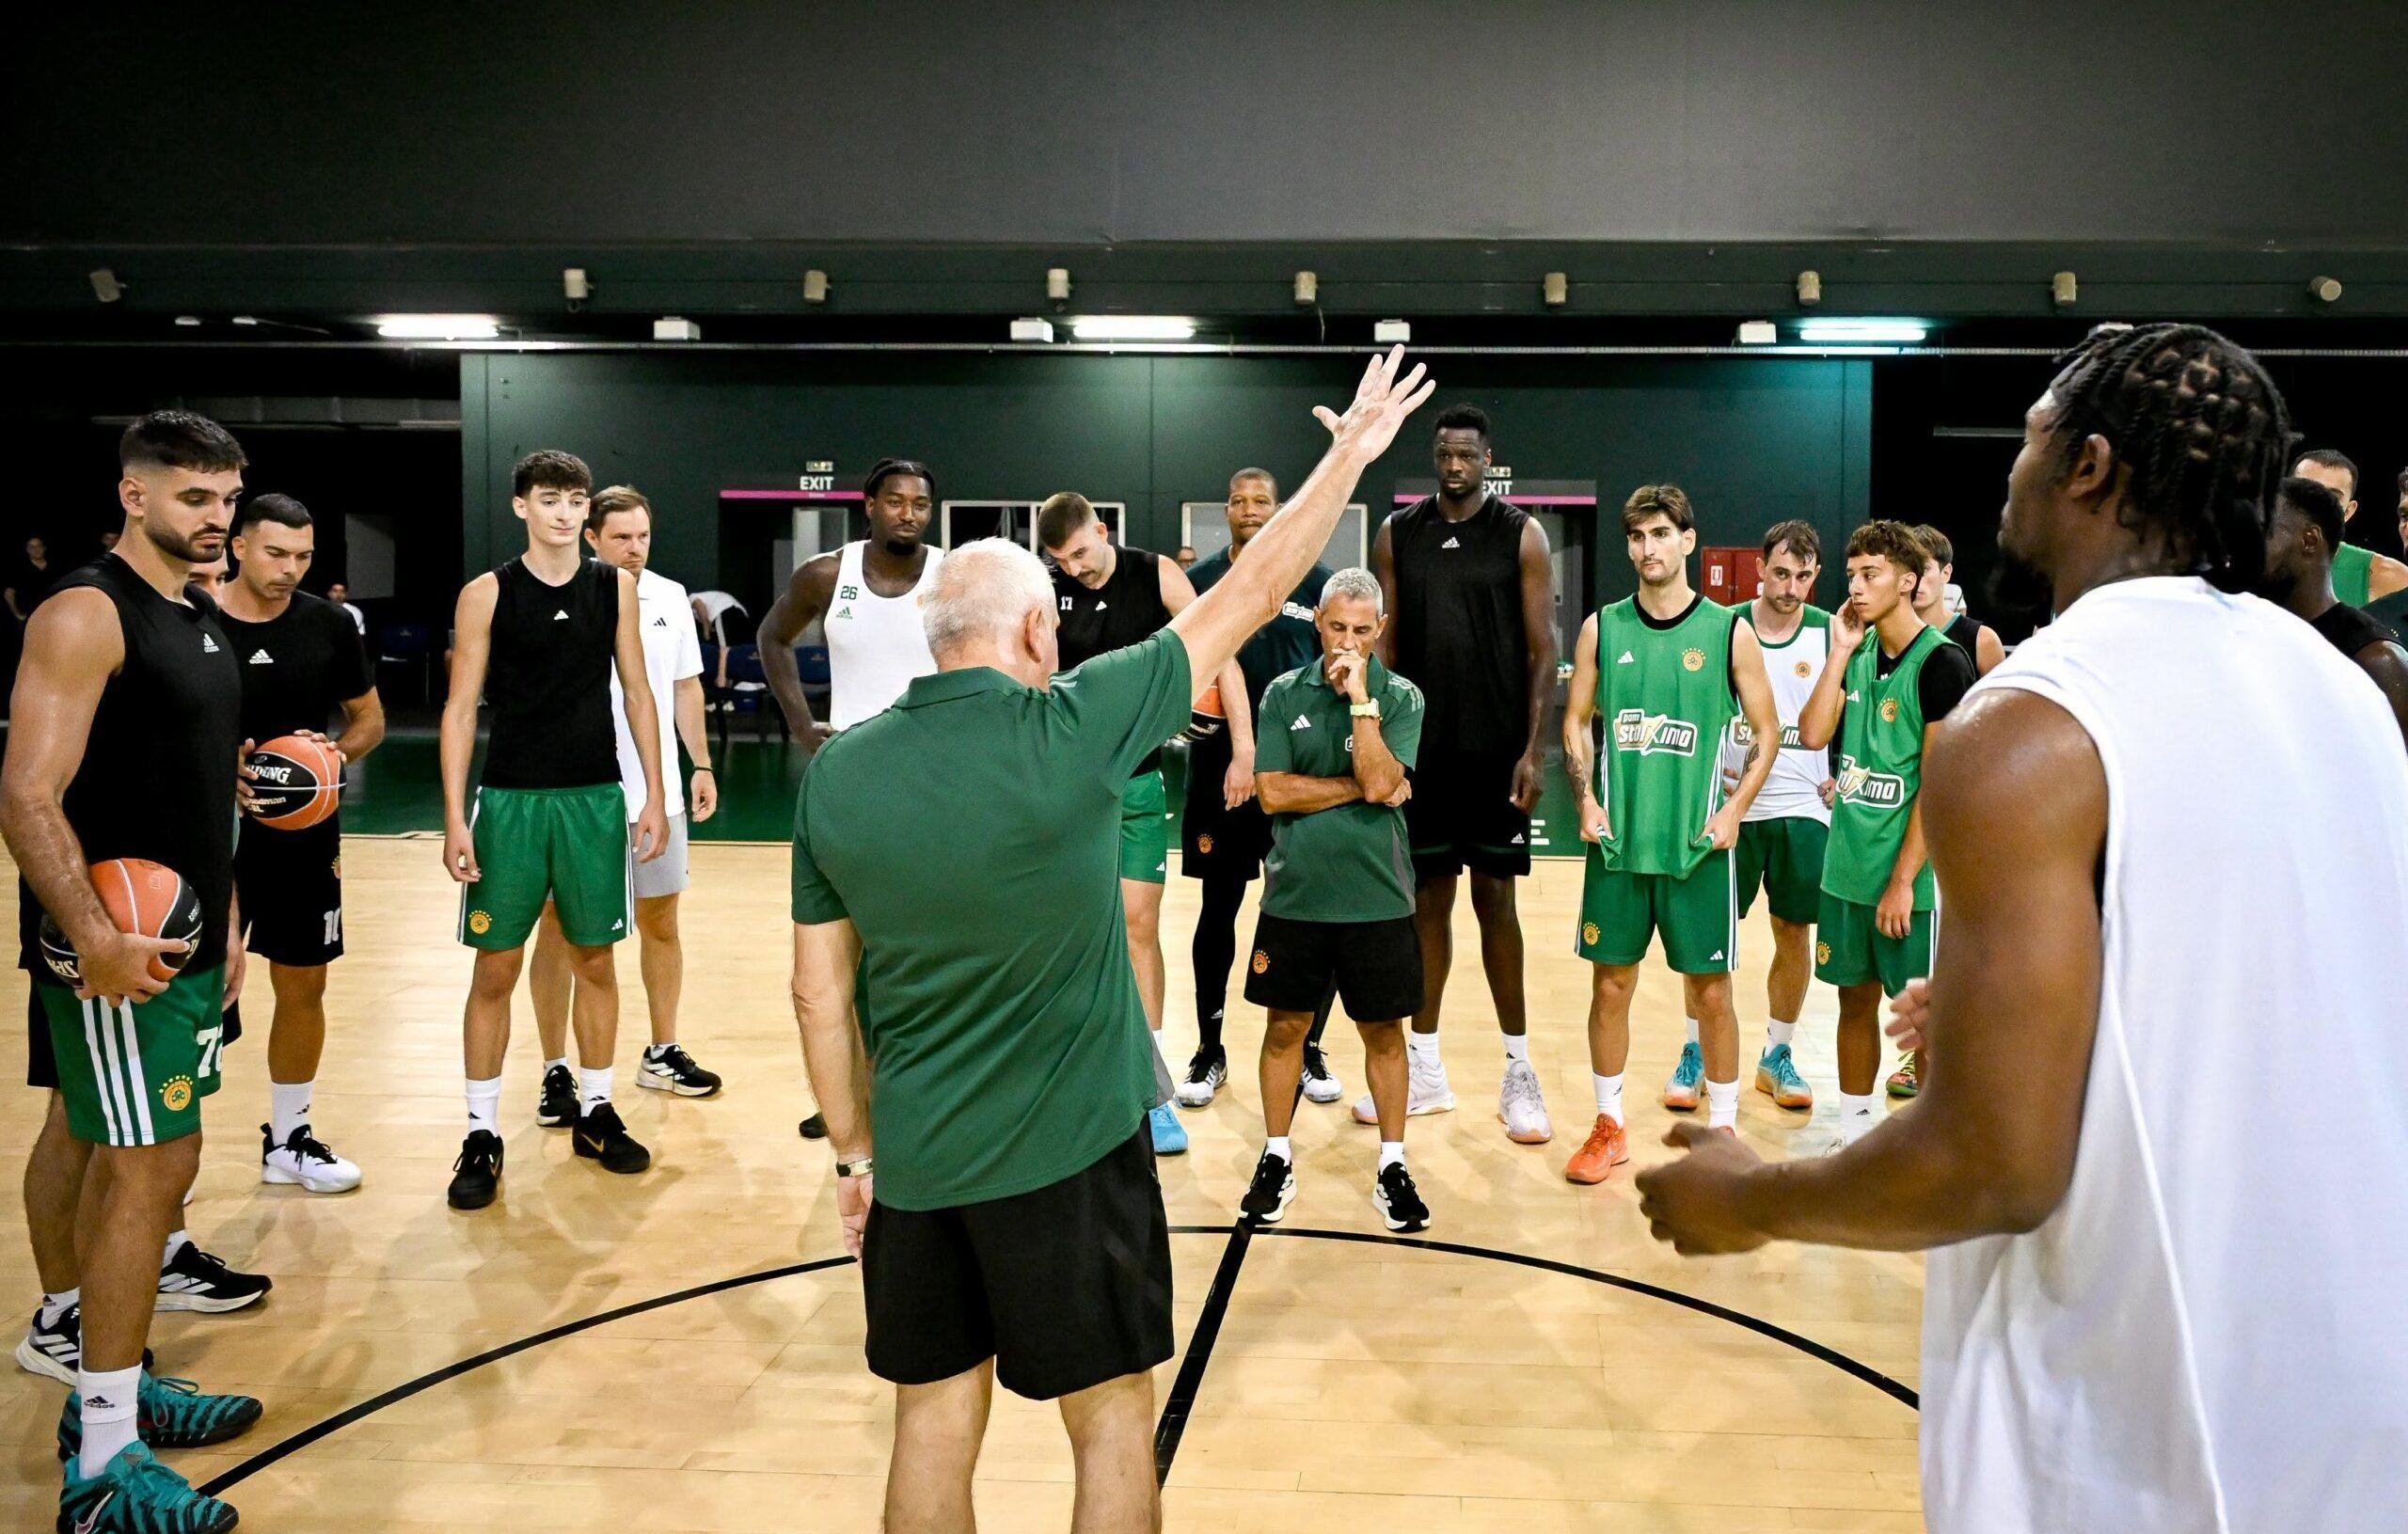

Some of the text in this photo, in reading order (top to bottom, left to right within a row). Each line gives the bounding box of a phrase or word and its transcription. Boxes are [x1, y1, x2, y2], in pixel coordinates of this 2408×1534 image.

[800, 475, 834, 491] EXIT
[840, 585, 858, 600] 26
[1060, 595, 1073, 610] 17
